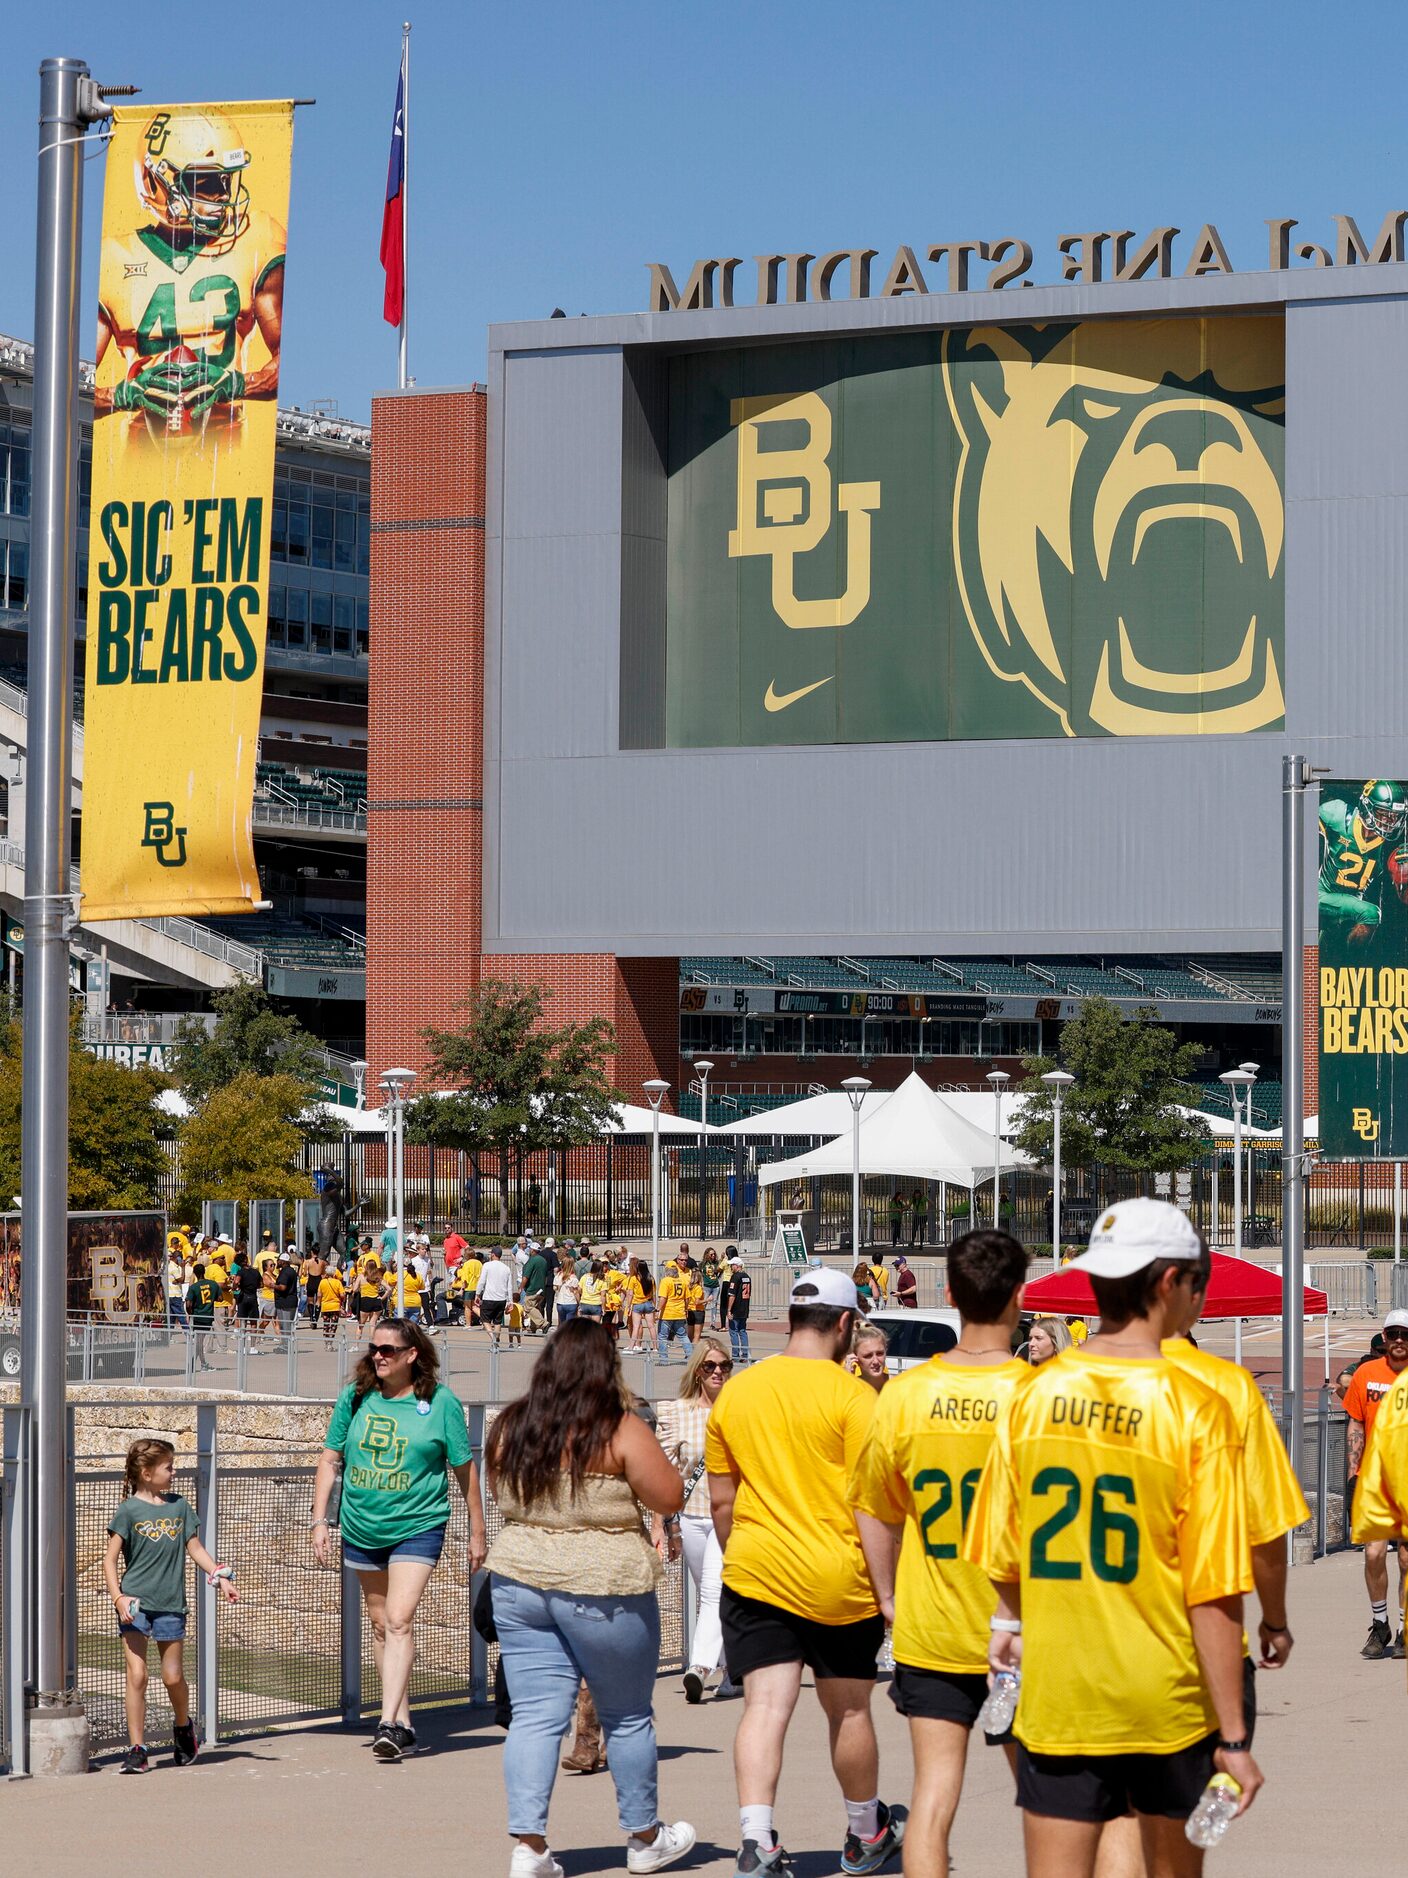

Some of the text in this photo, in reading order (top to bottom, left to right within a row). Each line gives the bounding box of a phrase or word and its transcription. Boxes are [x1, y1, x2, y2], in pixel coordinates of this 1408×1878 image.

[137, 274, 240, 370] 43
[728, 391, 880, 628] BU
[99, 497, 263, 587] SIC 'EM
[96, 584, 260, 685] BEARS
[141, 801, 188, 867] BU
[1336, 852, 1376, 890] 21
[867, 996, 893, 1010] 90:00
[1255, 1008, 1282, 1020] COWBOYS
[1215, 1140, 1249, 1148] DIMMTT
[1352, 1108, 1379, 1141] BU
[201, 1289, 212, 1304] 12
[674, 1283, 683, 1296] 15
[1052, 1396, 1143, 1437] DUFFER
[360, 1414, 408, 1472] BU
[350, 1466, 410, 1491] BAYLOR
[1030, 1467, 1140, 1584] 26
